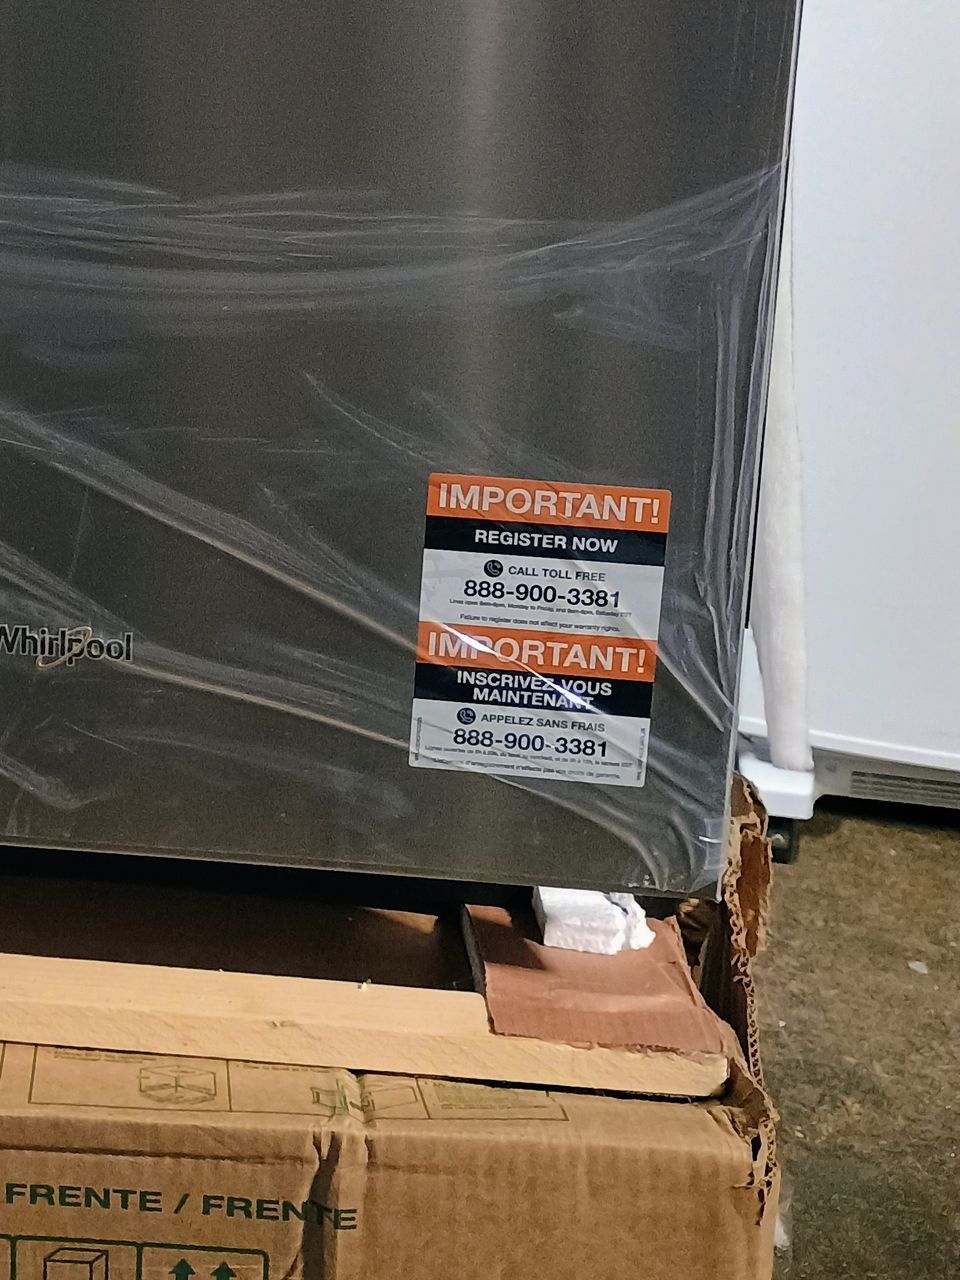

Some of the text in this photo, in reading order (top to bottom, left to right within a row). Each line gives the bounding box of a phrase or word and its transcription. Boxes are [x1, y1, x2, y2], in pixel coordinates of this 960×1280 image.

[439, 483, 660, 524] IMPORTANT!
[475, 529, 618, 553] REGISTER NOW
[508, 566, 606, 582] CALL TOLL FREE
[464, 579, 621, 608] 888-900-3381
[429, 631, 646, 673] IMPORTANT!
[480, 713, 605, 733] APPELEZ SANS FRAIS
[453, 728, 608, 758] 888-900-3381
[5, 1183, 162, 1213] FRENTE
[174, 1193, 190, 1215] /
[202, 1194, 358, 1231] FRENTE
